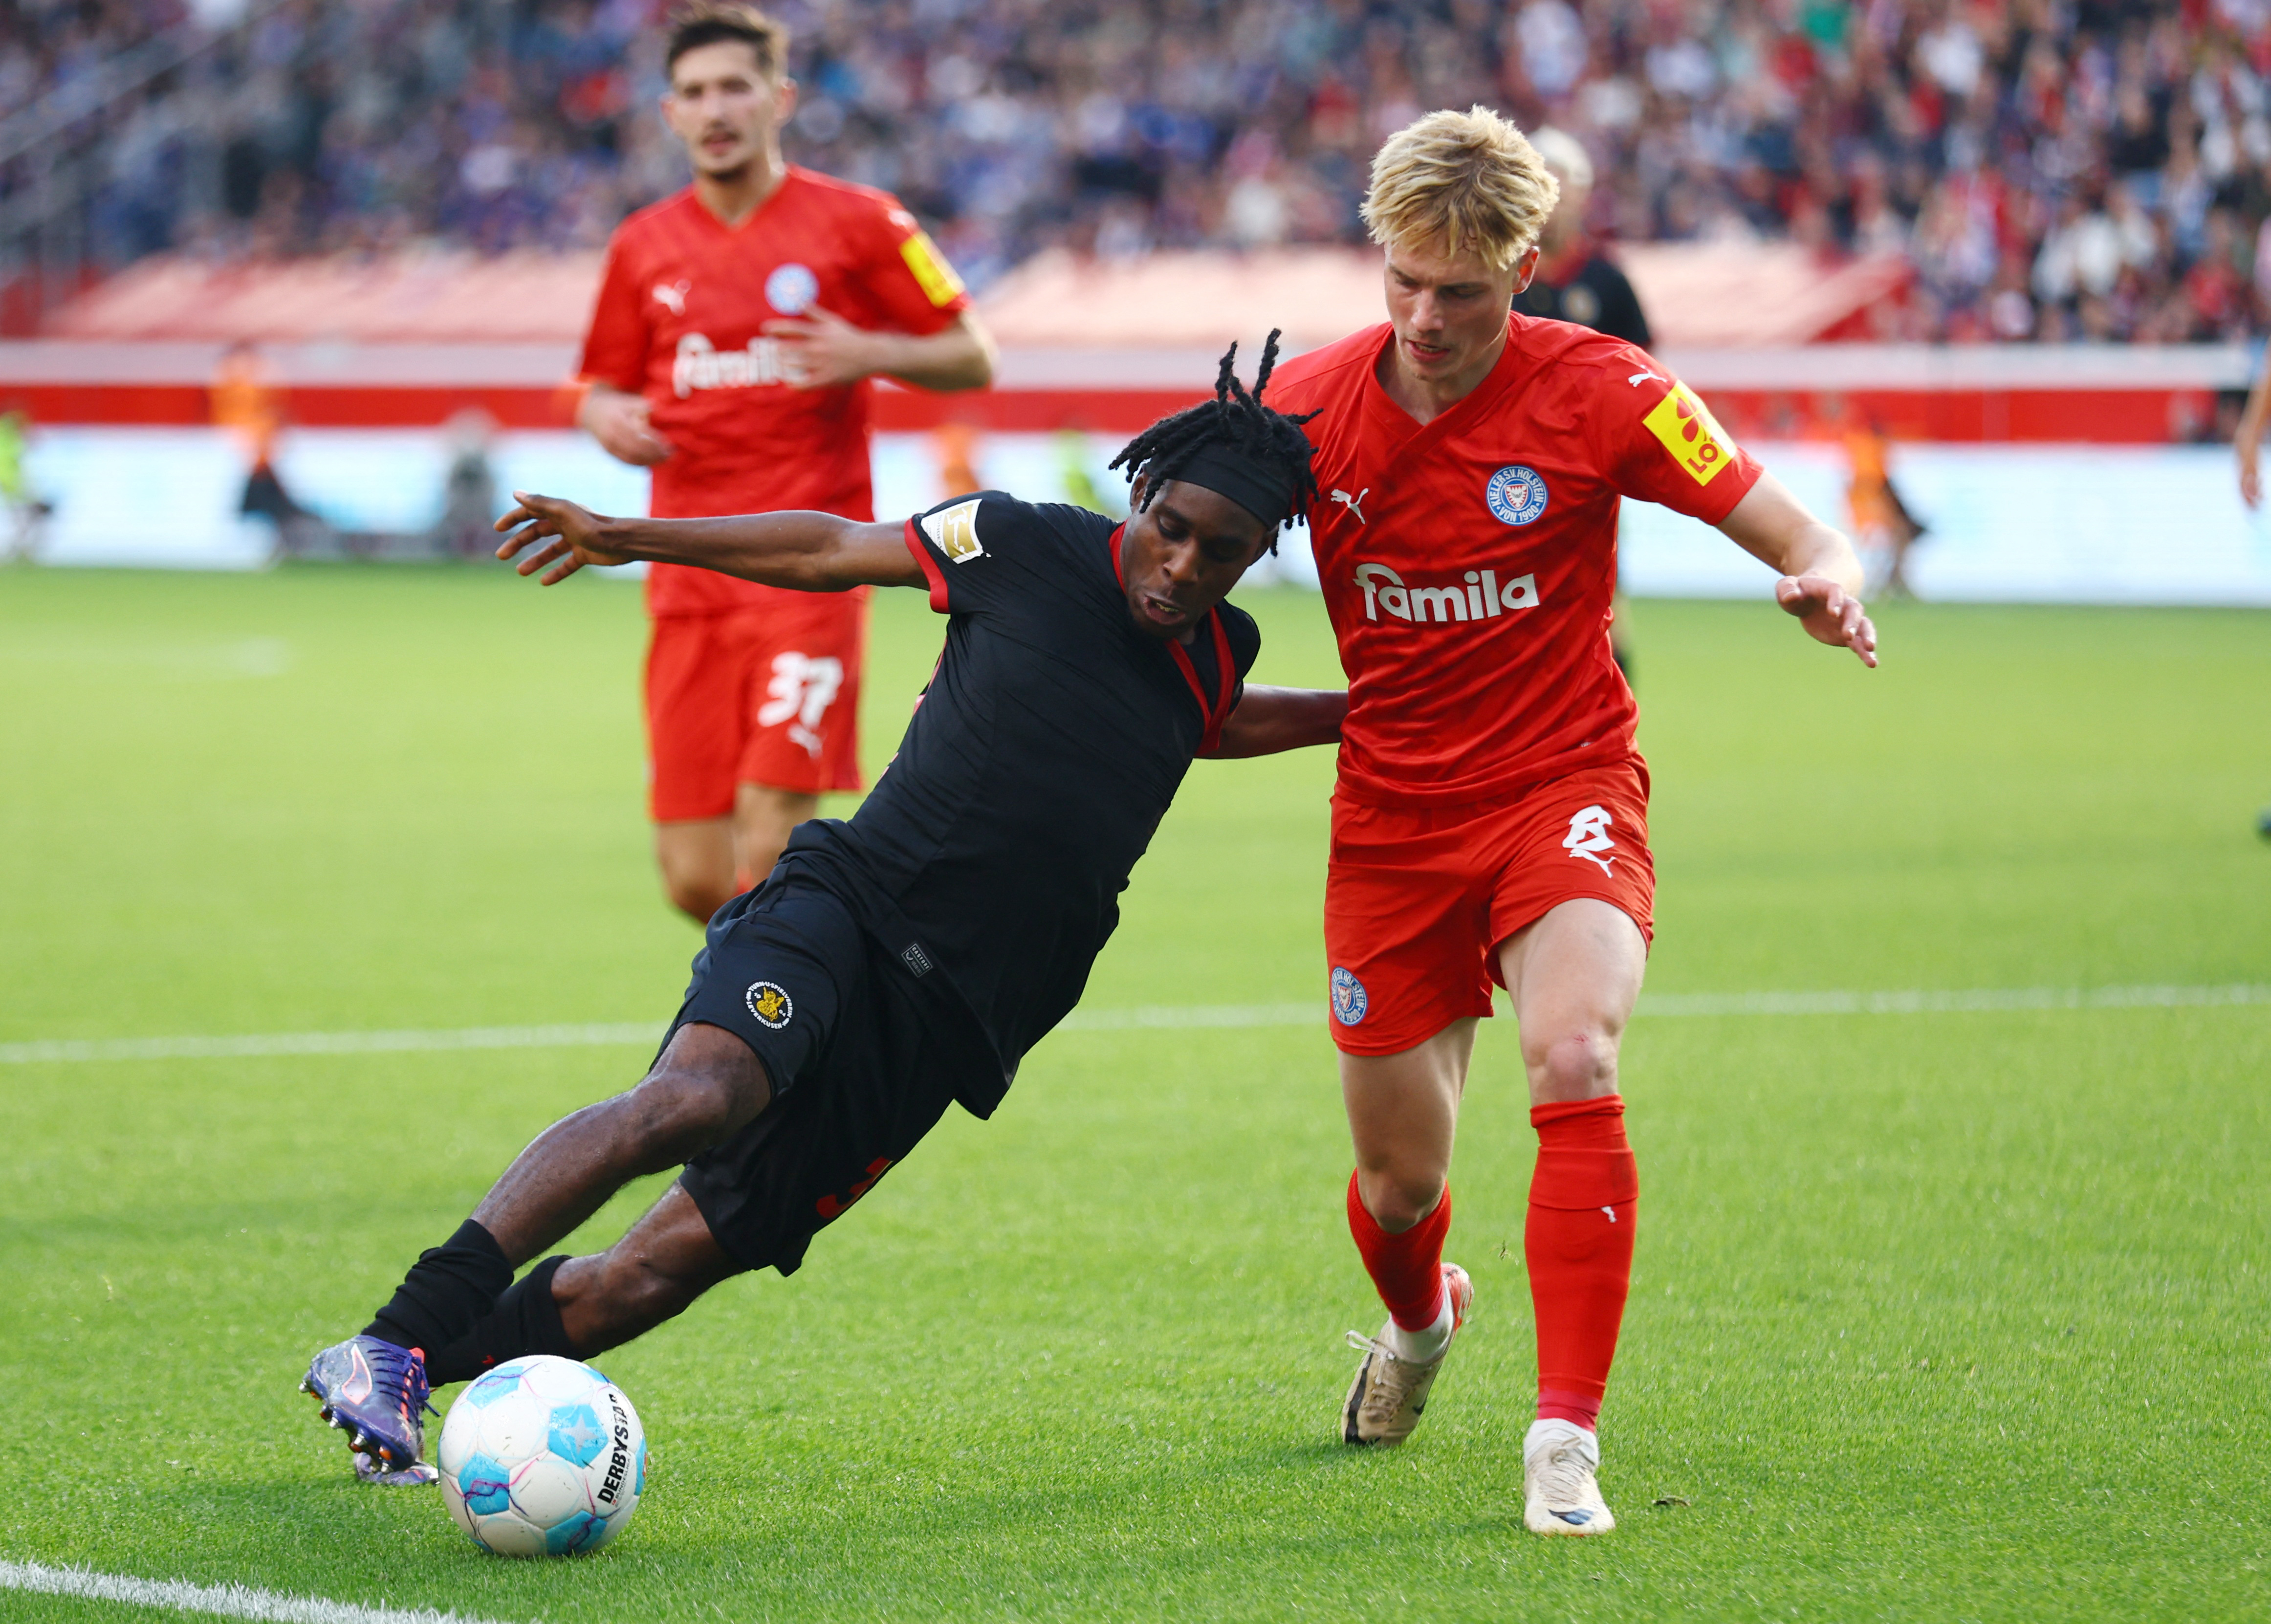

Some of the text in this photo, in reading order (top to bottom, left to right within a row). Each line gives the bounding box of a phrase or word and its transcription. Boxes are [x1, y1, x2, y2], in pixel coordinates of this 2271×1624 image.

[1489, 468, 1545, 507] KIELER S.V. HOLSTEIN
[1499, 504, 1539, 522] VON 1900
[1353, 563, 1540, 622] famila
[757, 650, 845, 732] 37
[912, 946, 930, 969] CASTORE
[1343, 972, 1365, 1009] HOLSTEIN
[746, 1001, 783, 1029] LEVERKUSEN
[615, 1458, 630, 1499] BUNDESLIGA
